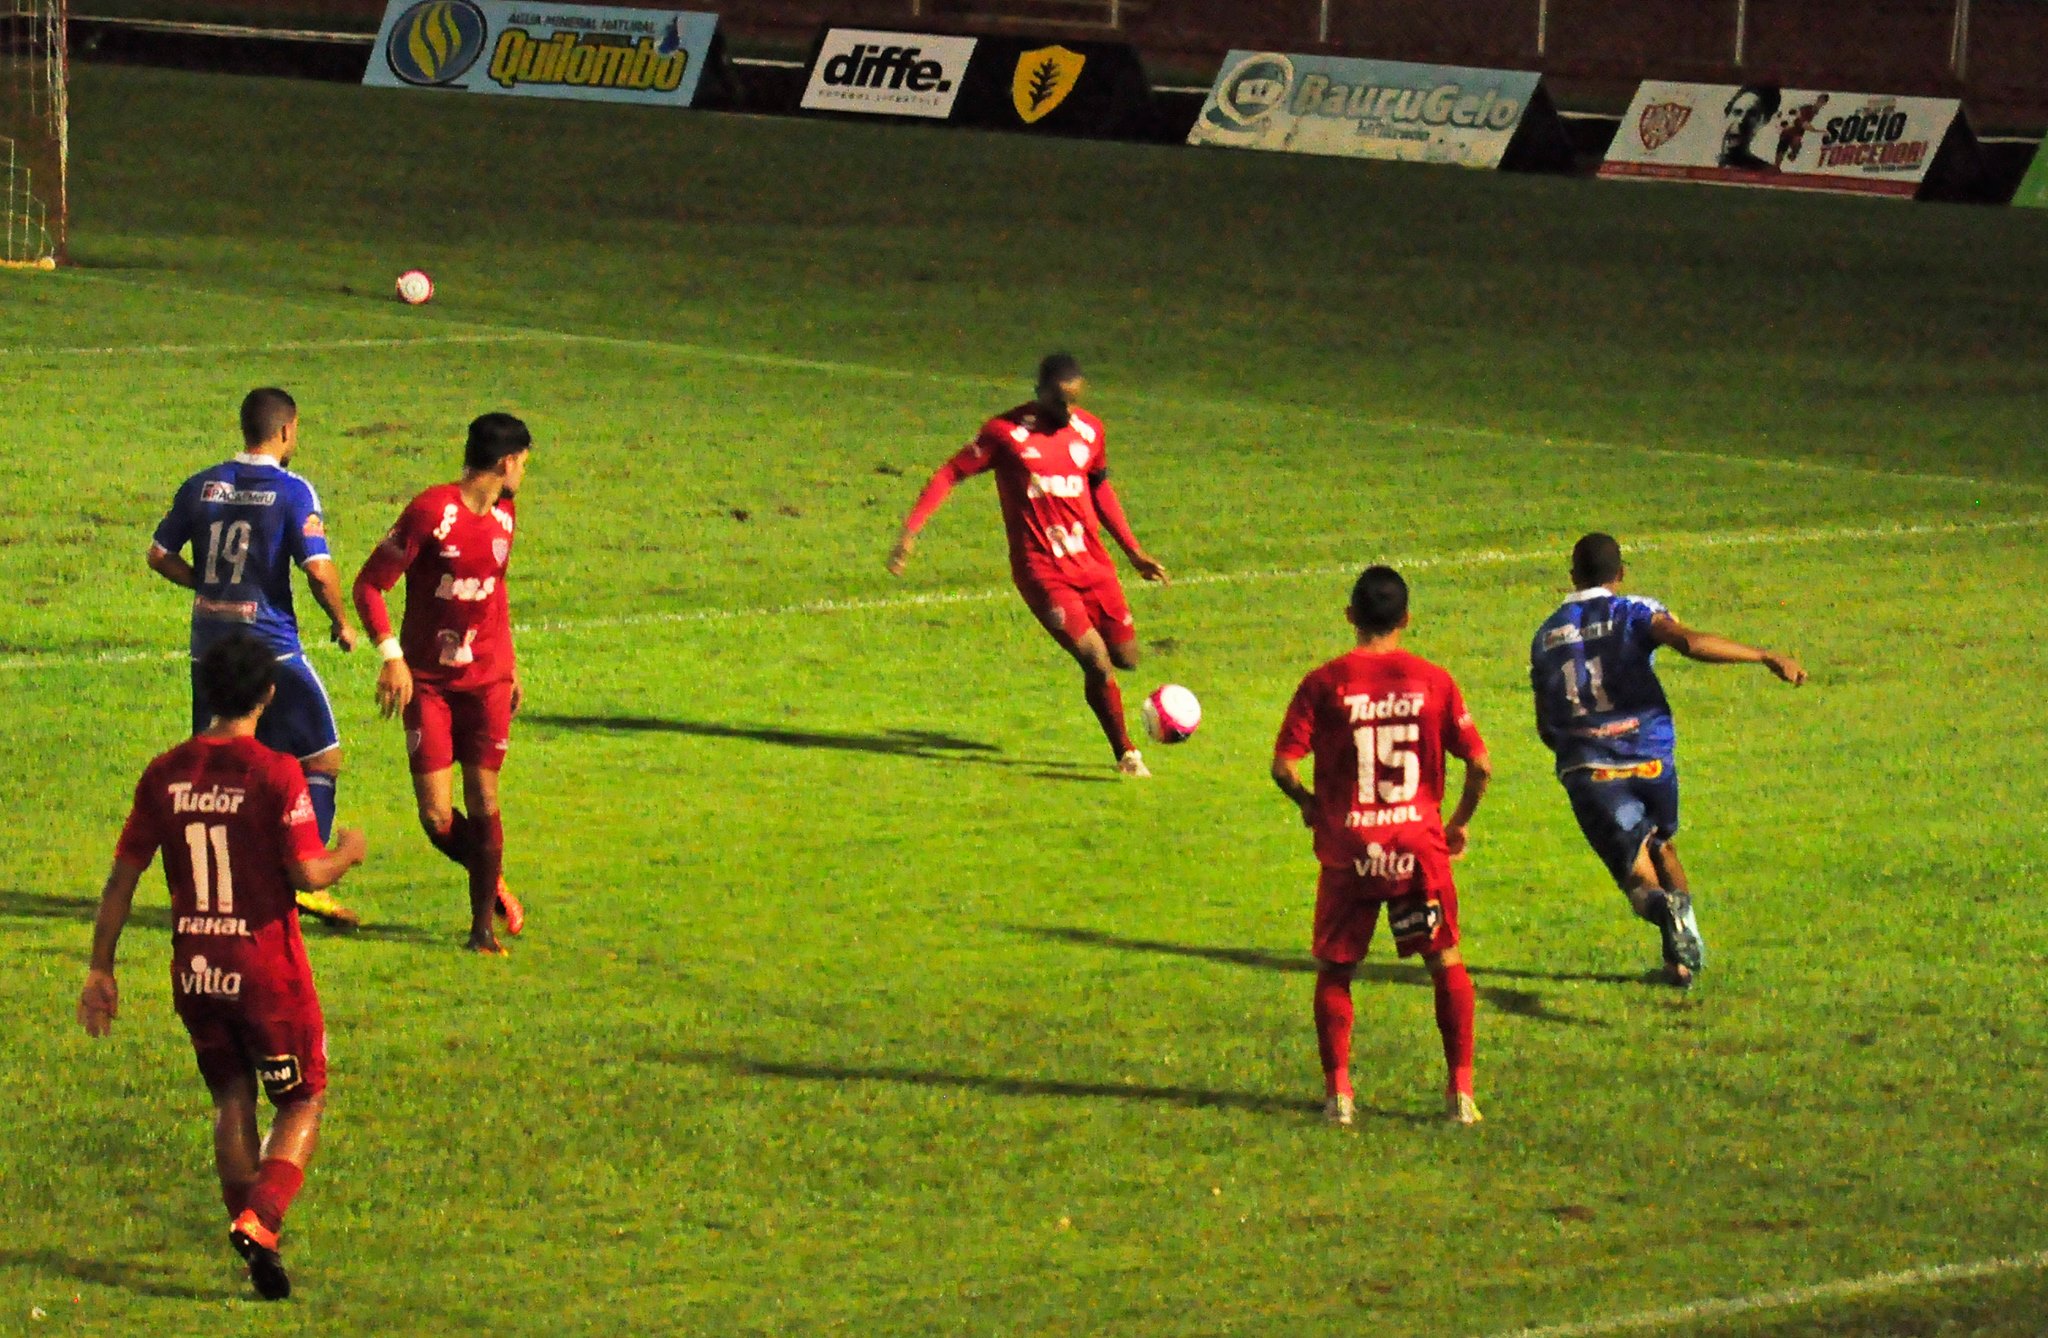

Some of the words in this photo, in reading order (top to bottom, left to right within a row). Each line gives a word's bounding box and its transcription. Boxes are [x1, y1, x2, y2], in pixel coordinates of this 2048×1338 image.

[490, 27, 687, 91] Quilombo
[1290, 73, 1519, 130] BauruGelo
[203, 520, 252, 585] 19
[1343, 692, 1425, 724] Tudor
[1561, 656, 1615, 719] 11
[1352, 724, 1420, 804] 15
[168, 782, 245, 815] Tudor
[185, 822, 234, 914] 11
